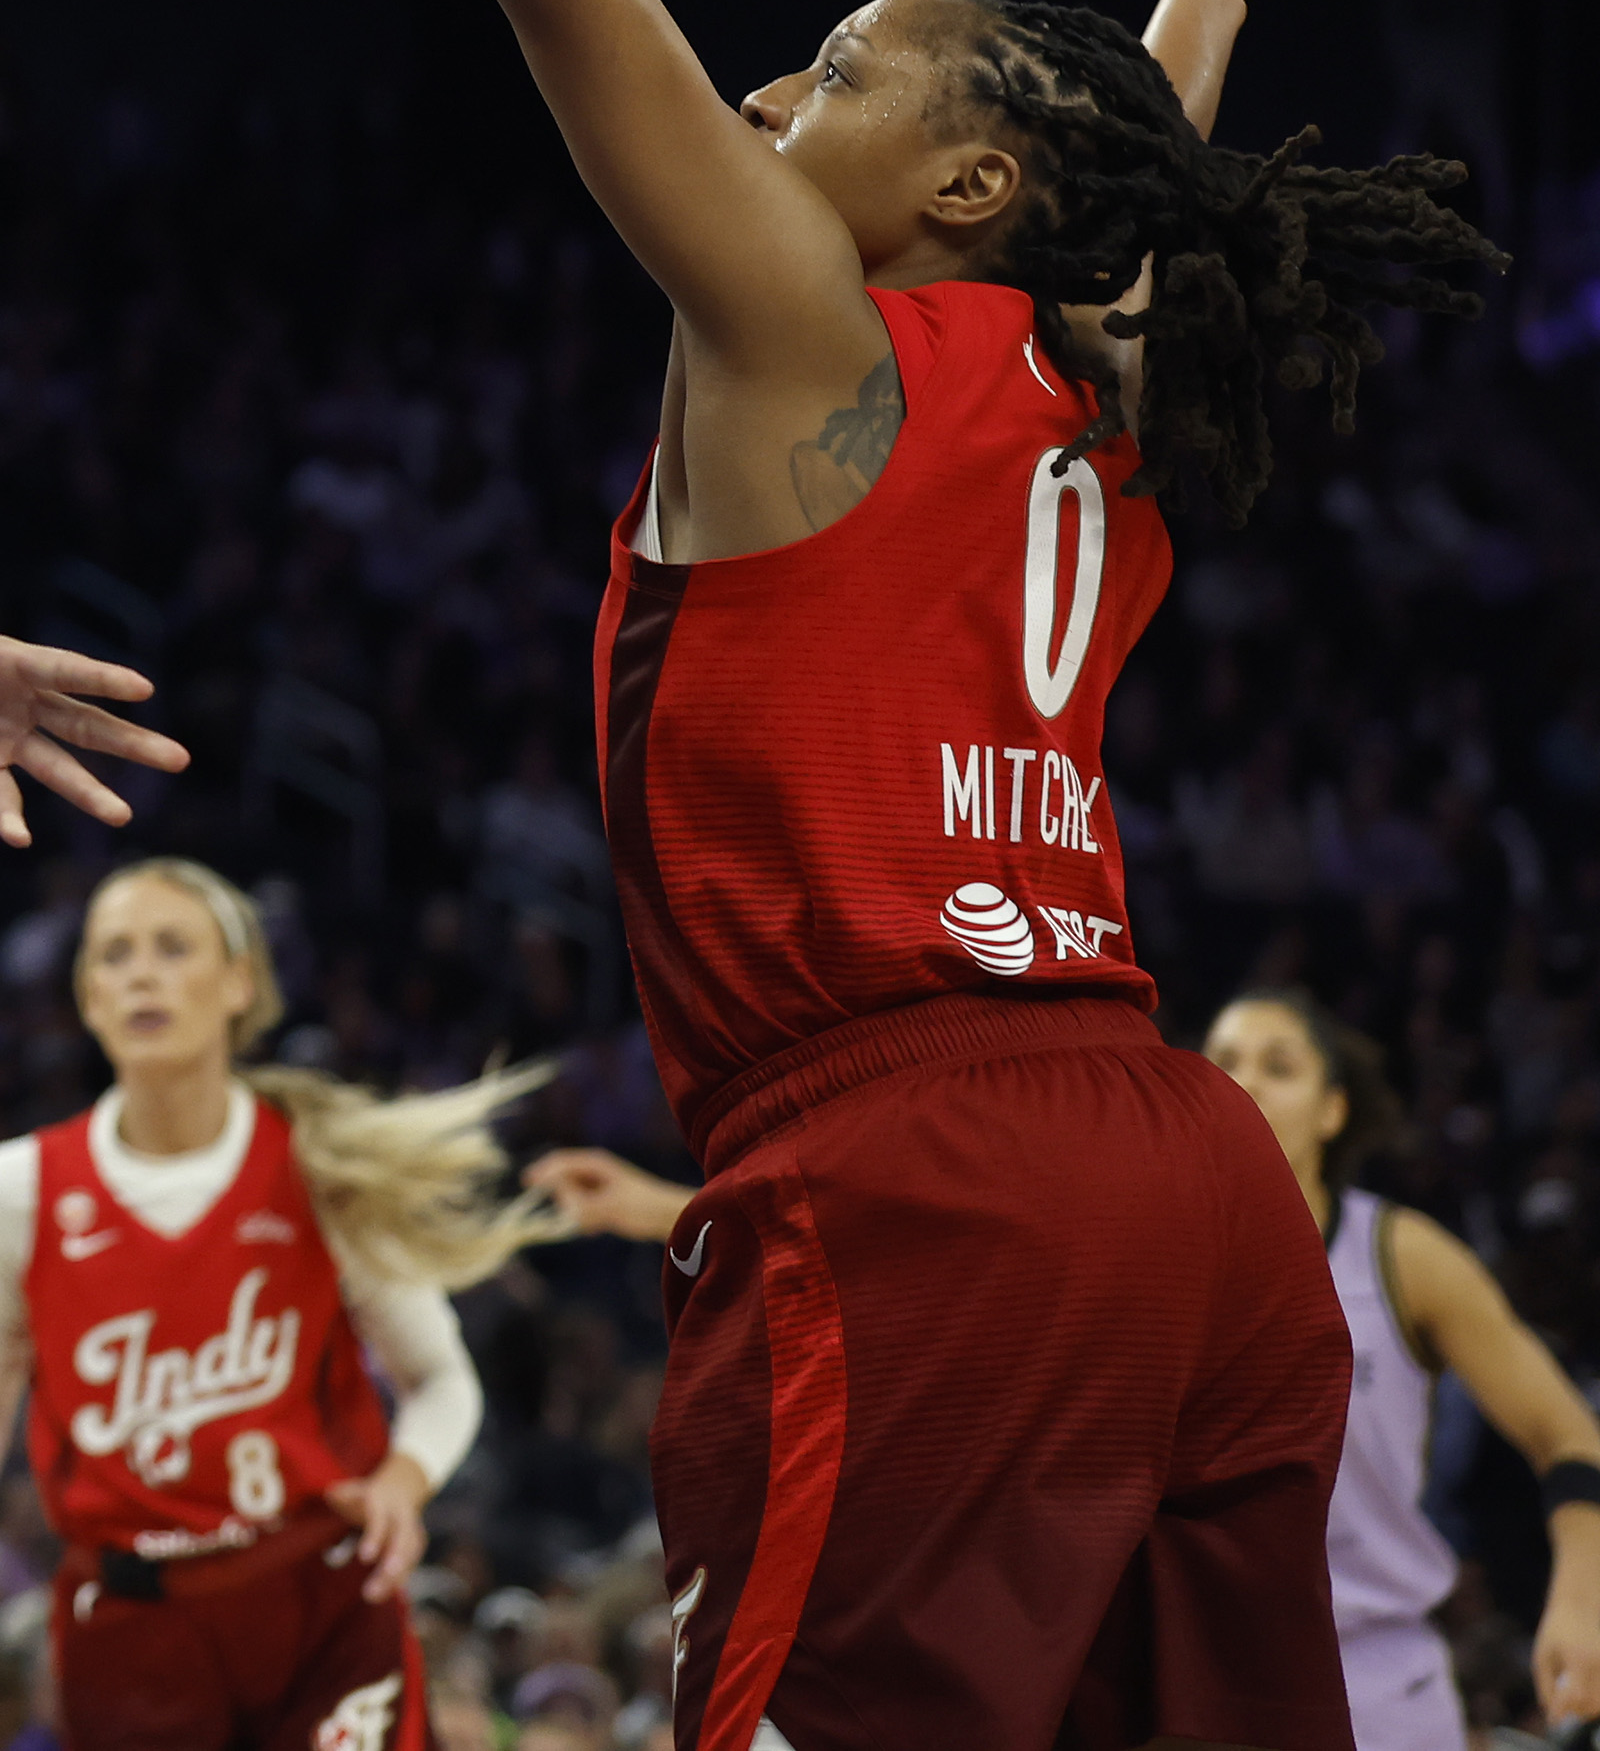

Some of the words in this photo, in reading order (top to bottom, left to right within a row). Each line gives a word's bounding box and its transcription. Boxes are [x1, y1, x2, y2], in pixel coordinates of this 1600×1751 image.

[1022, 447, 1106, 720] 0
[940, 742, 1104, 854] MITCHE
[72, 1268, 301, 1456] Indy
[226, 1431, 284, 1520] 8
